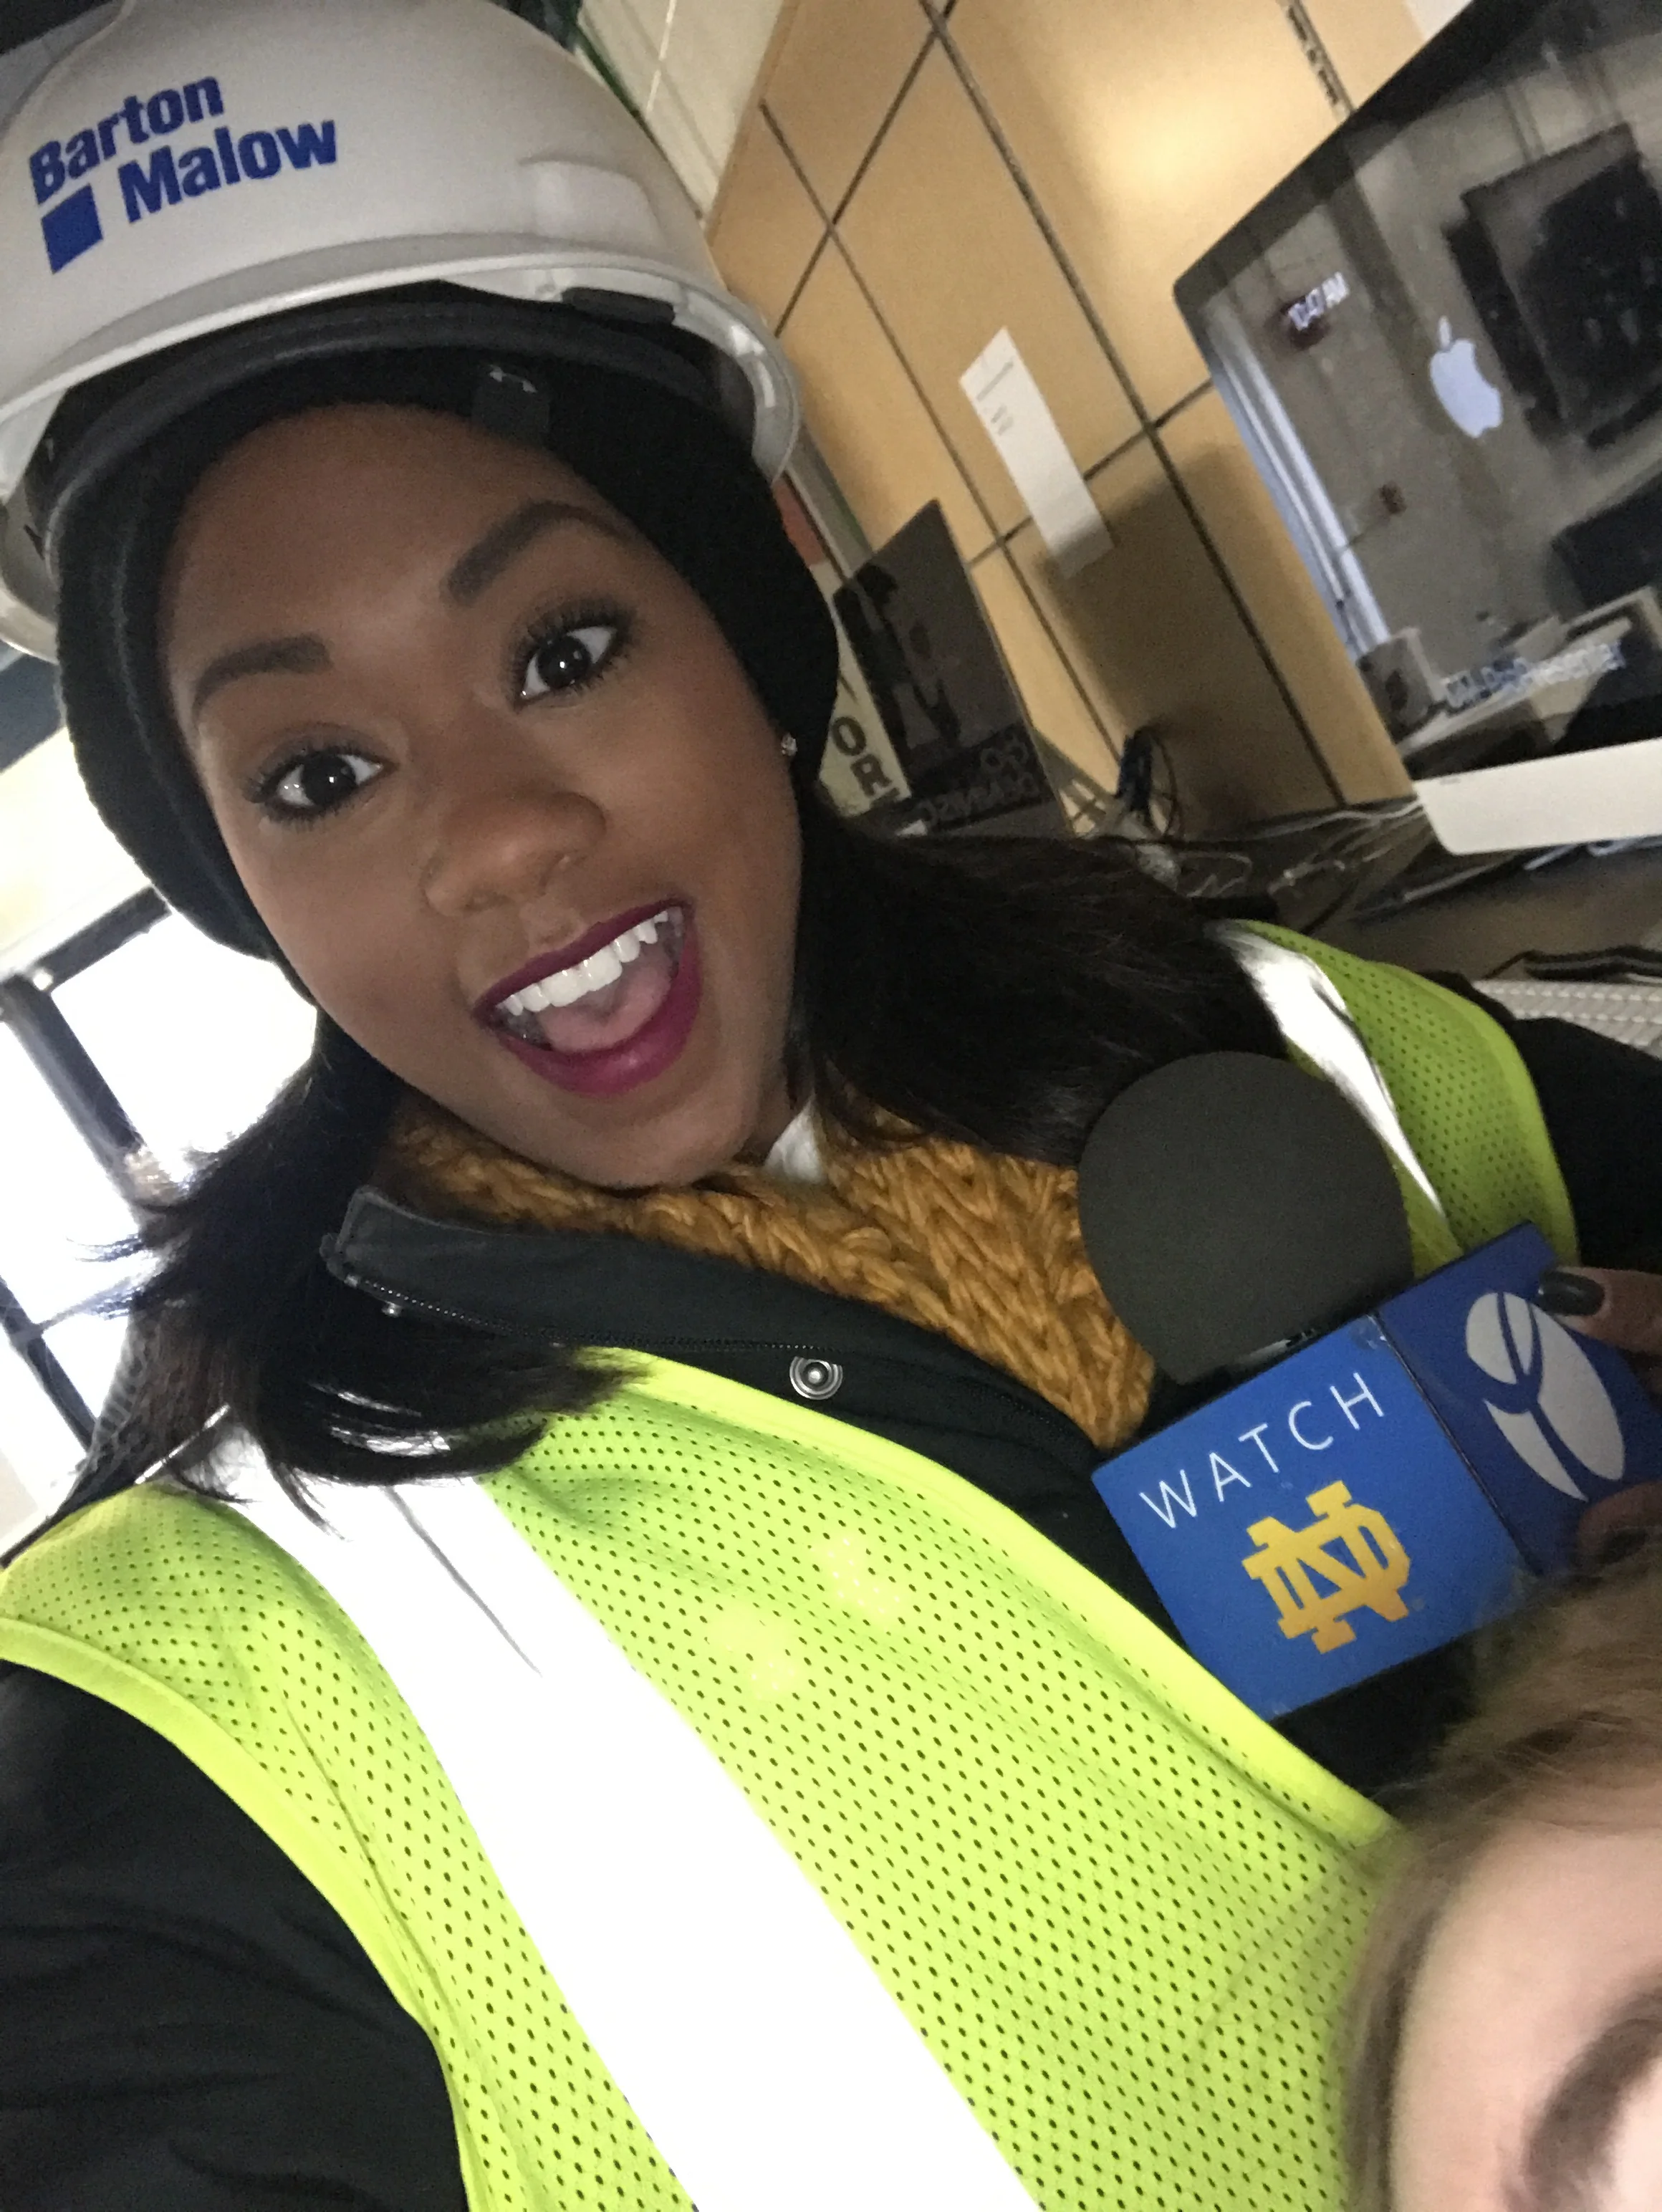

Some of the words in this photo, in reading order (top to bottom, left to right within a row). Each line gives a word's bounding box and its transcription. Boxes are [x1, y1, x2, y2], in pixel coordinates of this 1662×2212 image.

[29, 76, 225, 205] Barton
[117, 120, 337, 223] Malow
[1138, 1372, 1385, 1529] WATCH
